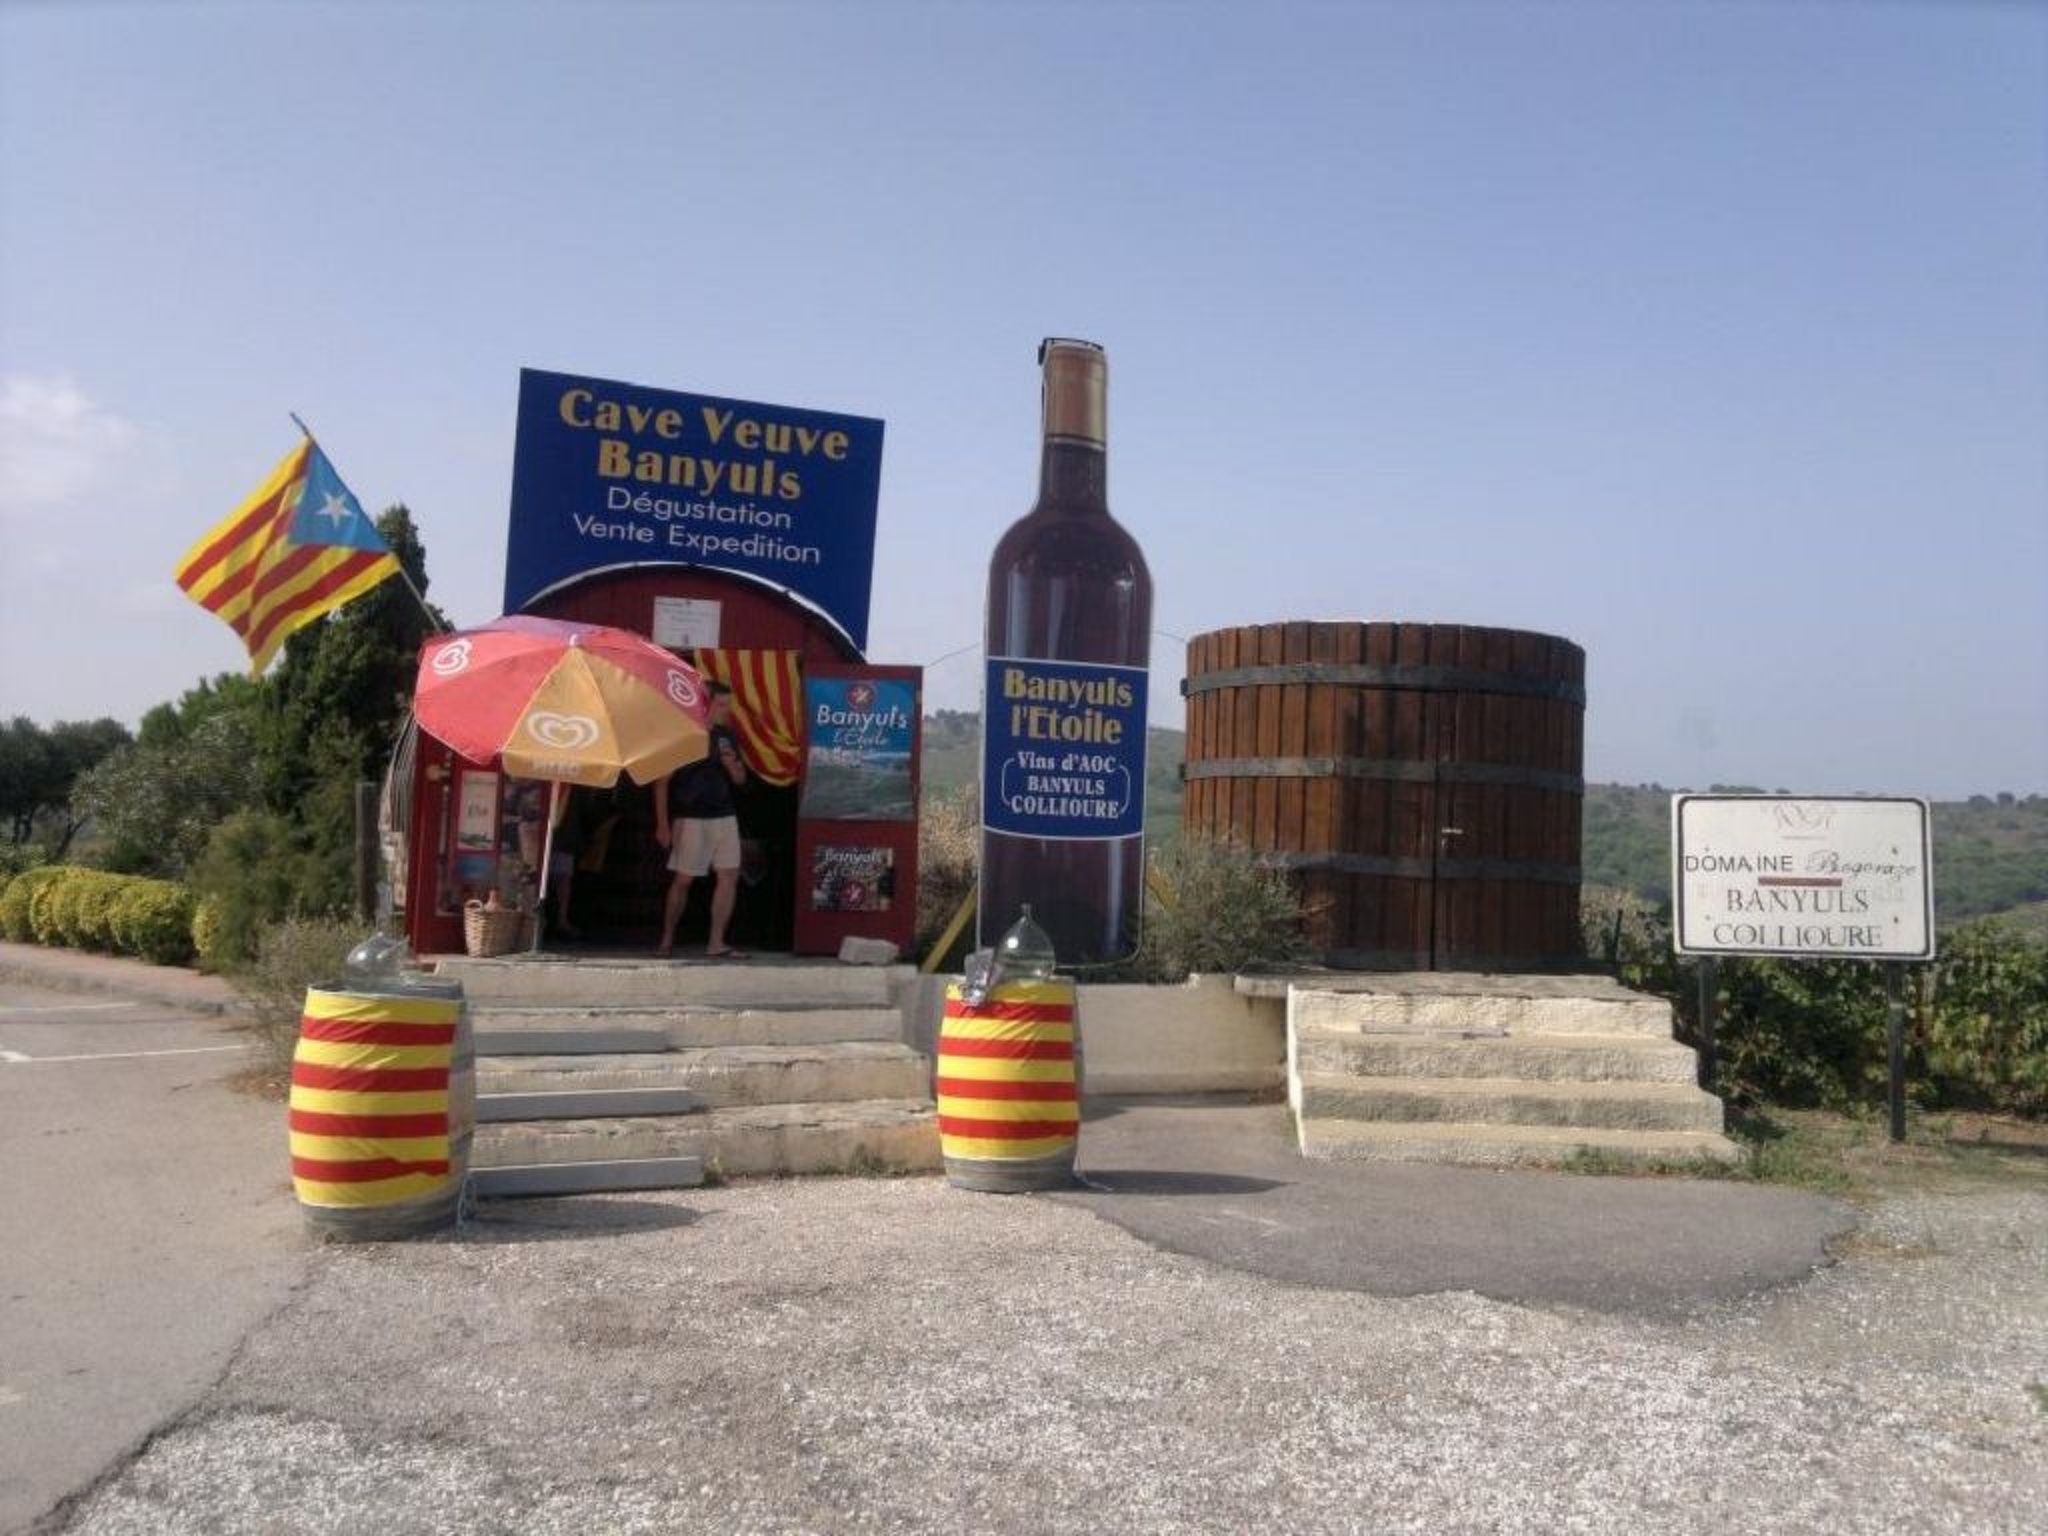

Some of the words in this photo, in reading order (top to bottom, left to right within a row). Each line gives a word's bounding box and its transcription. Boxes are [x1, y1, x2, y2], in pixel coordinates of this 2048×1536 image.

[559, 387, 684, 439] Cave
[702, 406, 850, 461] Veuve
[597, 439, 802, 500] Banyuls
[607, 485, 792, 530] Dégustation
[573, 512, 655, 544] Vente
[668, 524, 821, 565] Expedition
[1003, 667, 1134, 710] Banyuls
[816, 703, 908, 733] Banyuls
[1010, 703, 1123, 746] l'Etoile
[1017, 750, 1056, 771] Vins
[1061, 753, 1117, 774] d'AOC
[1027, 774, 1106, 796] BANYULS
[1010, 795, 1120, 820] COLLIOURE
[1685, 854, 1793, 873] DOMAINE
[1726, 888, 1870, 914] BANYULS
[1713, 923, 1884, 948] COLLIOURE
